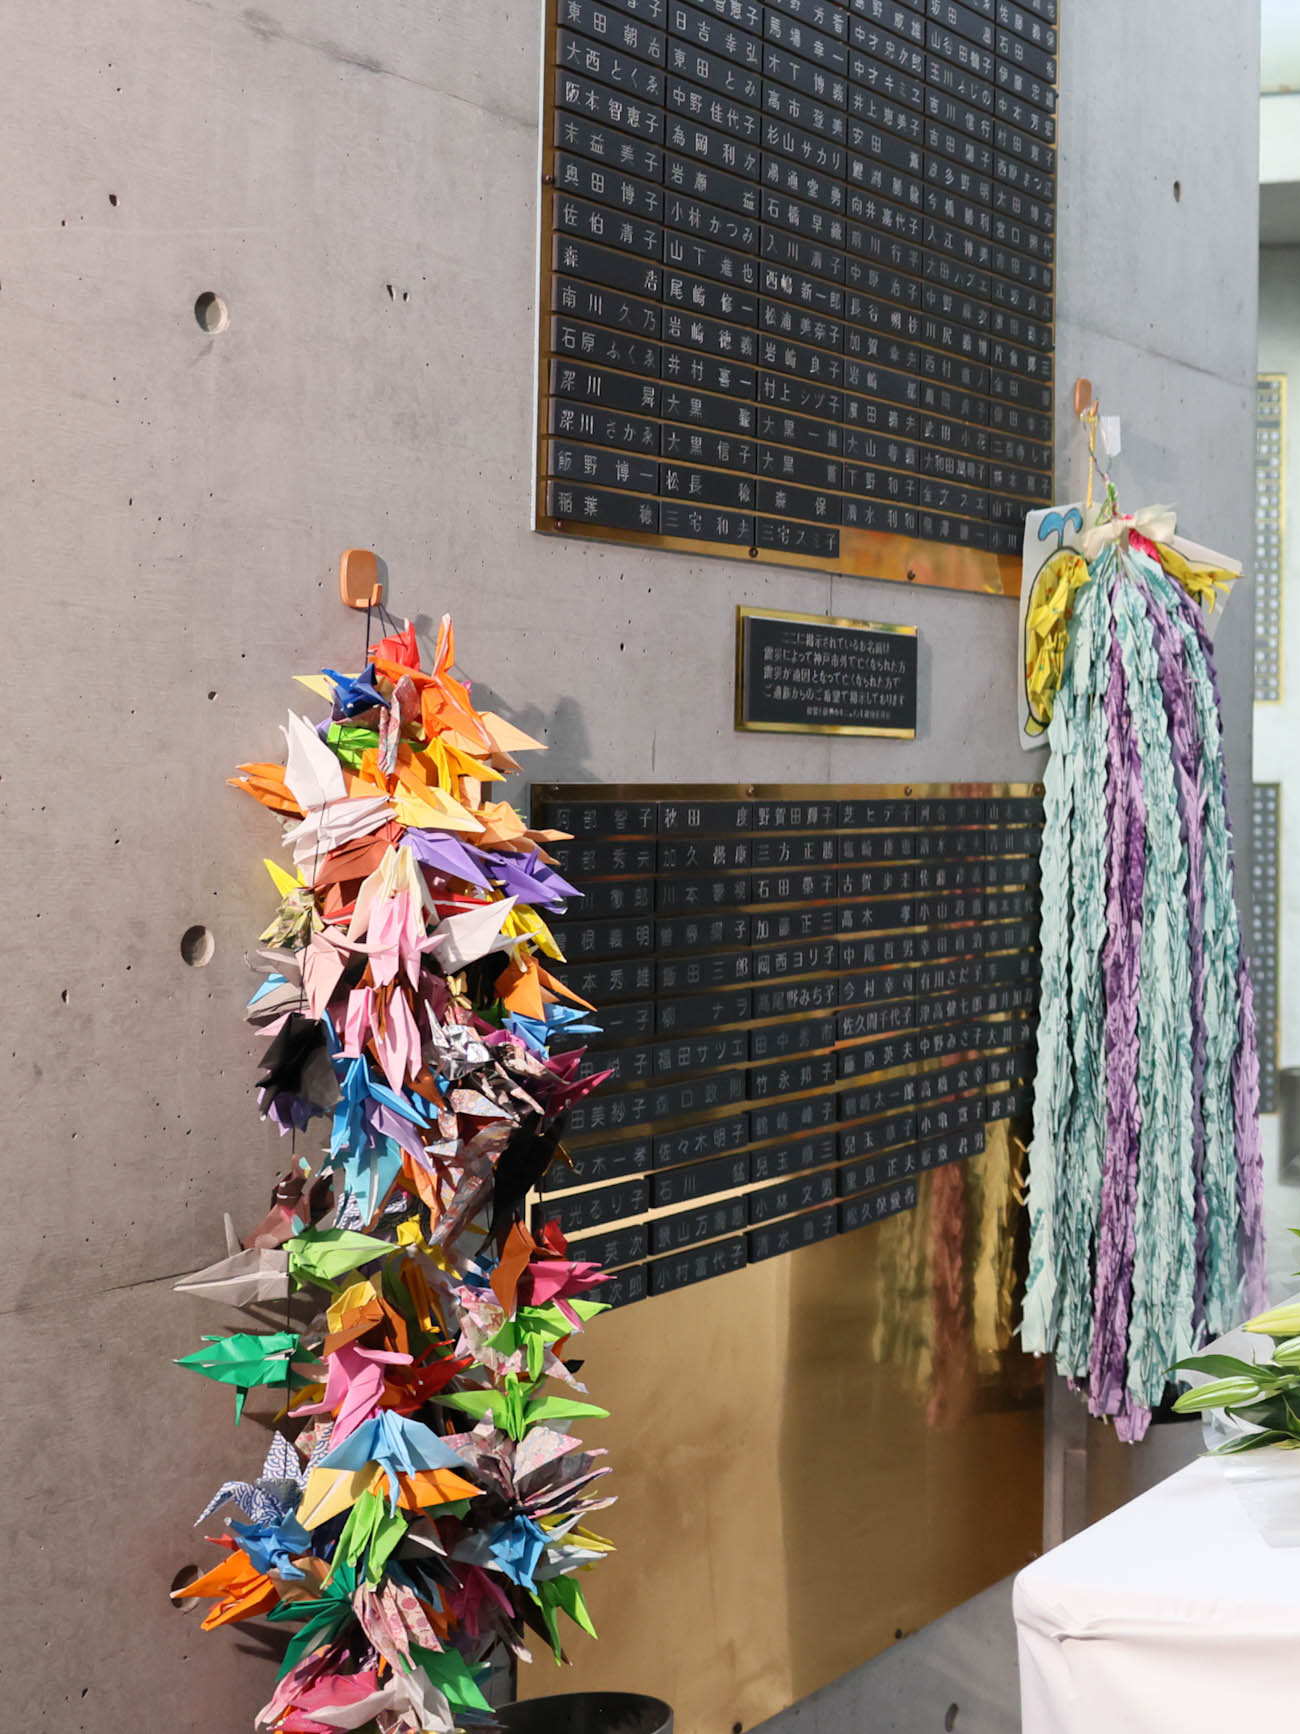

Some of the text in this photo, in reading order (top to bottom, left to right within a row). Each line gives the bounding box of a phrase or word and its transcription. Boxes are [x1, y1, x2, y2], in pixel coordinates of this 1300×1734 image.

[567, 0, 660, 58] 東田朝治
[675, 10, 757, 62] 日吉幸弘
[769, 16, 844, 61] 馬場幸一
[673, 48, 755, 97] 東田とみ
[768, 54, 843, 102] 木下博義
[672, 86, 755, 134] 中野佳代子
[767, 89, 842, 134] 高市登美
[672, 125, 755, 170] 為岡利次
[767, 124, 840, 170] 杉山サカリ
[564, 203, 657, 250] 佐伯清子
[671, 201, 753, 244] 小林かつみ
[563, 245, 658, 291] 森浩
[562, 285, 655, 330] 南川久乃
[669, 278, 752, 313] 尾崎修一
[765, 270, 840, 309] 西嶋新一郎
[764, 305, 839, 344] 松浦美奈子
[667, 354, 751, 388] 井村喜一
[558, 450, 653, 482] 飯野博一
[667, 431, 750, 464] 大黒信子
[774, 489, 826, 516] 森保
[847, 468, 915, 497] 下野和子
[667, 508, 750, 540] 三宅和夫
[757, 945, 834, 974] 岡西ヨリ子
[842, 1006, 911, 1035] 佐久間千代子
[756, 1061, 832, 1094] 竹永邦子
[658, 1123, 743, 1161] 佐々木明子
